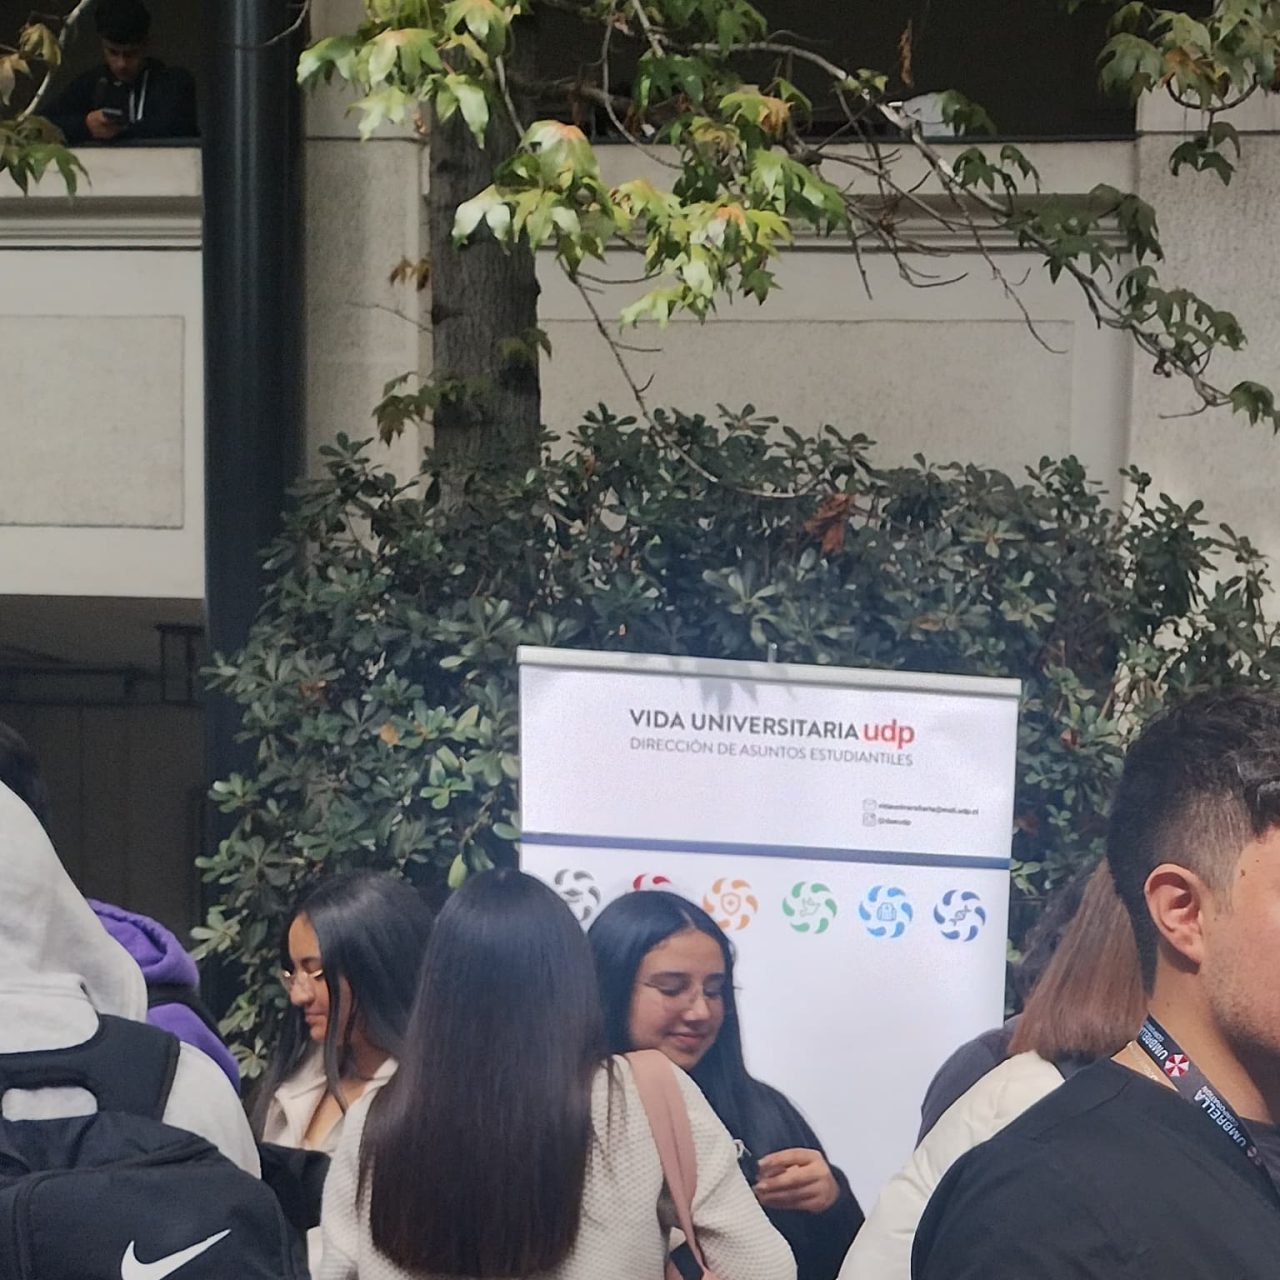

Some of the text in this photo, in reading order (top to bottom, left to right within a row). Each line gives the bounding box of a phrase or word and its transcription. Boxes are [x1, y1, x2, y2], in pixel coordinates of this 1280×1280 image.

[629, 708, 916, 749] VIDA UNIVERSITARIA udp
[629, 736, 914, 767] DIRECCIÓN DE ASUNTOS ESTUDIANTILES
[1193, 1088, 1247, 1147] UMBRELLA
